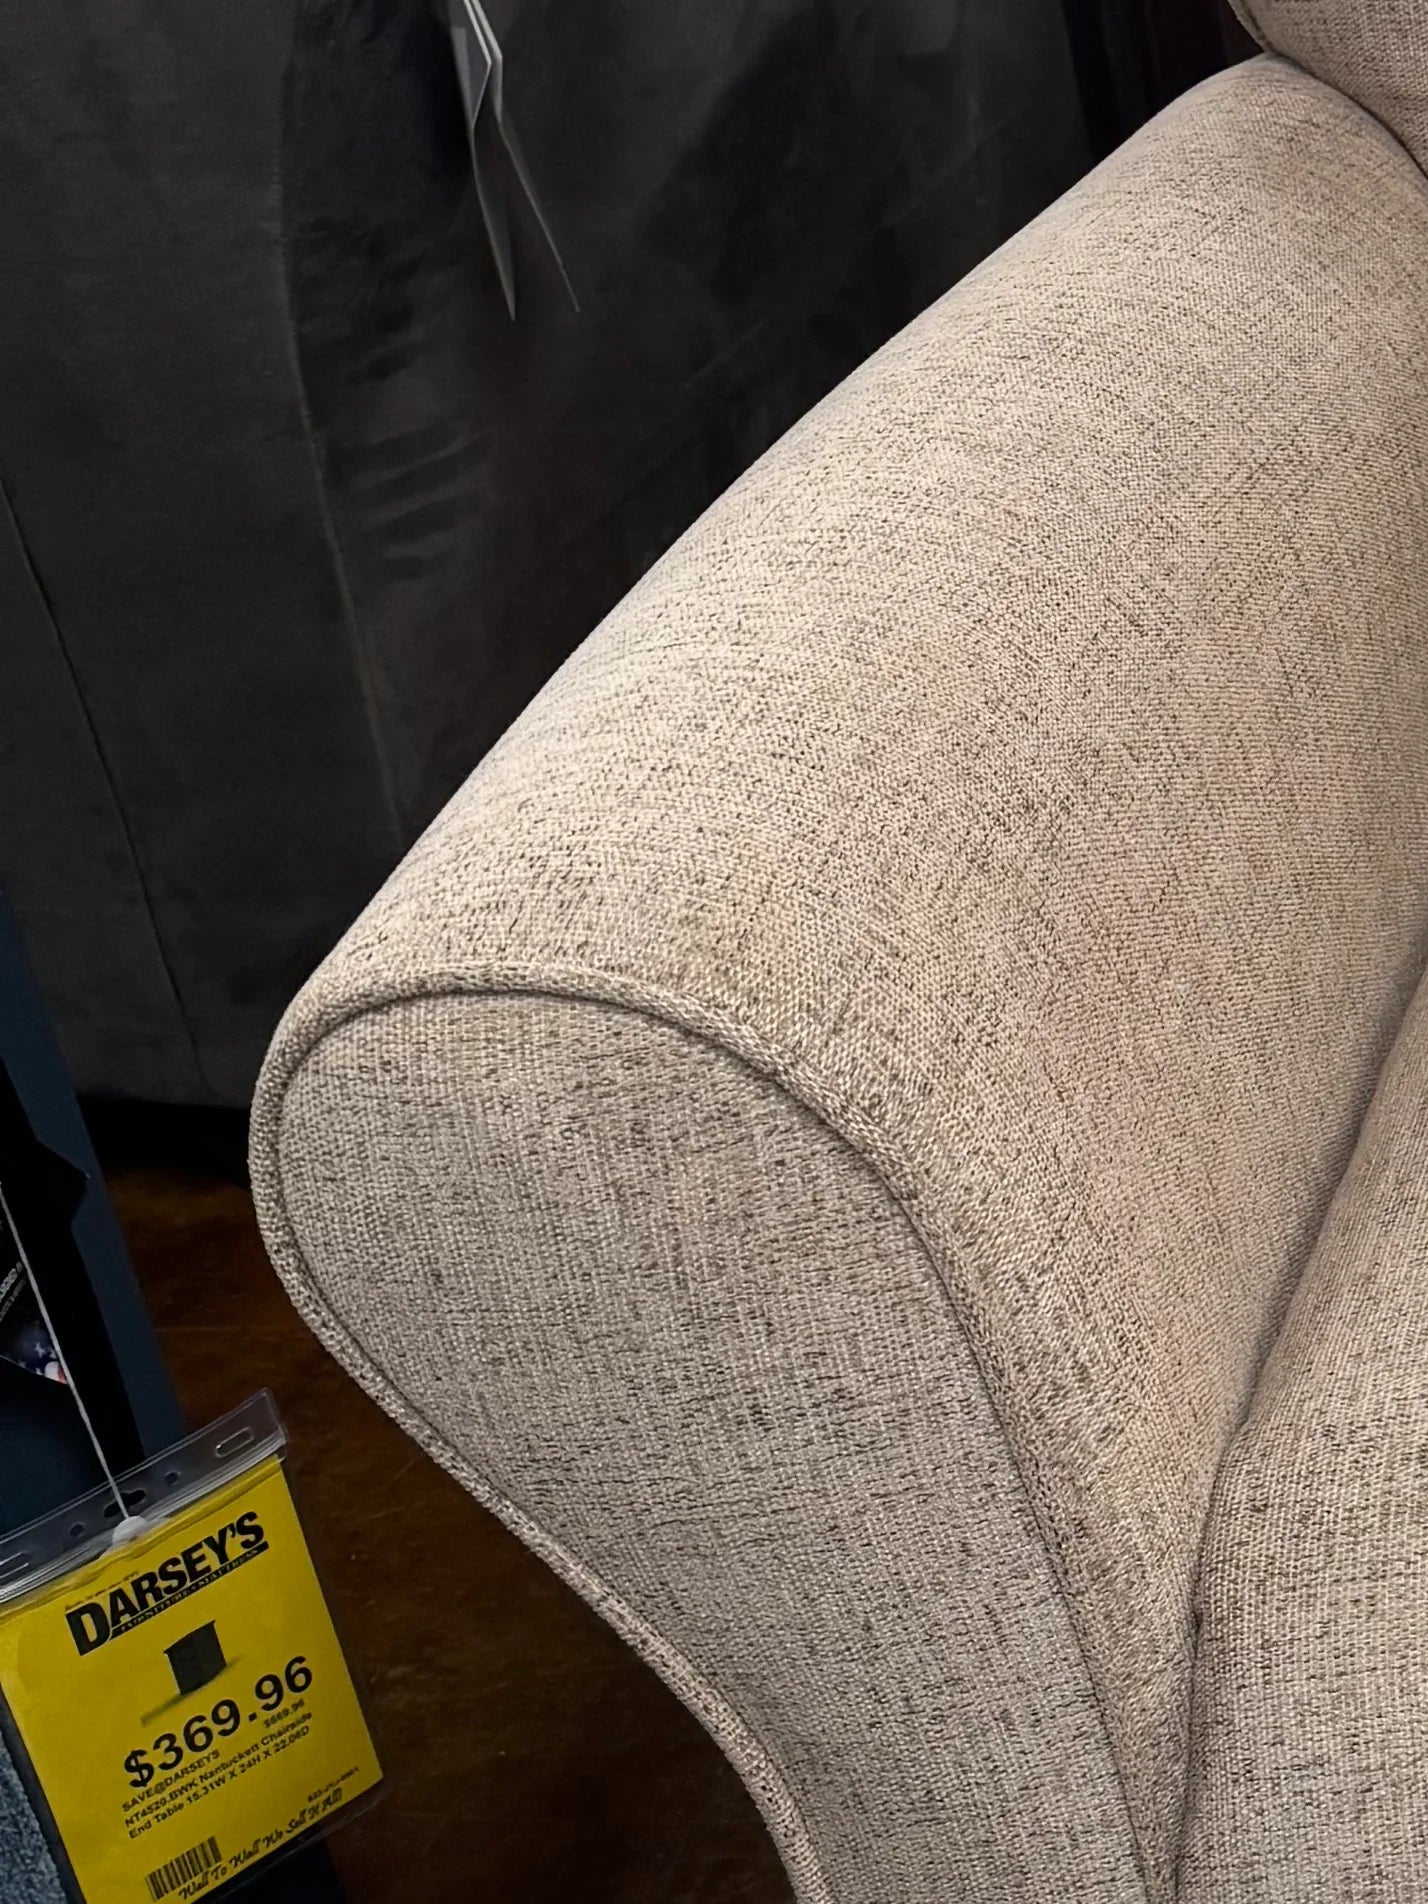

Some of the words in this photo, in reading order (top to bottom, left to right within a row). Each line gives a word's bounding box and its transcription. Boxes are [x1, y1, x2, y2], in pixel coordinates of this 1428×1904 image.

[65, 1511, 265, 1656] DARSEY'S
[123, 1655, 313, 1788] $369.96
[260, 1712, 312, 1746] Chairside
[121, 1749, 220, 1812] SAVE@DARSEYS
[128, 1821, 153, 1840] End
[153, 1801, 185, 1824] Table
